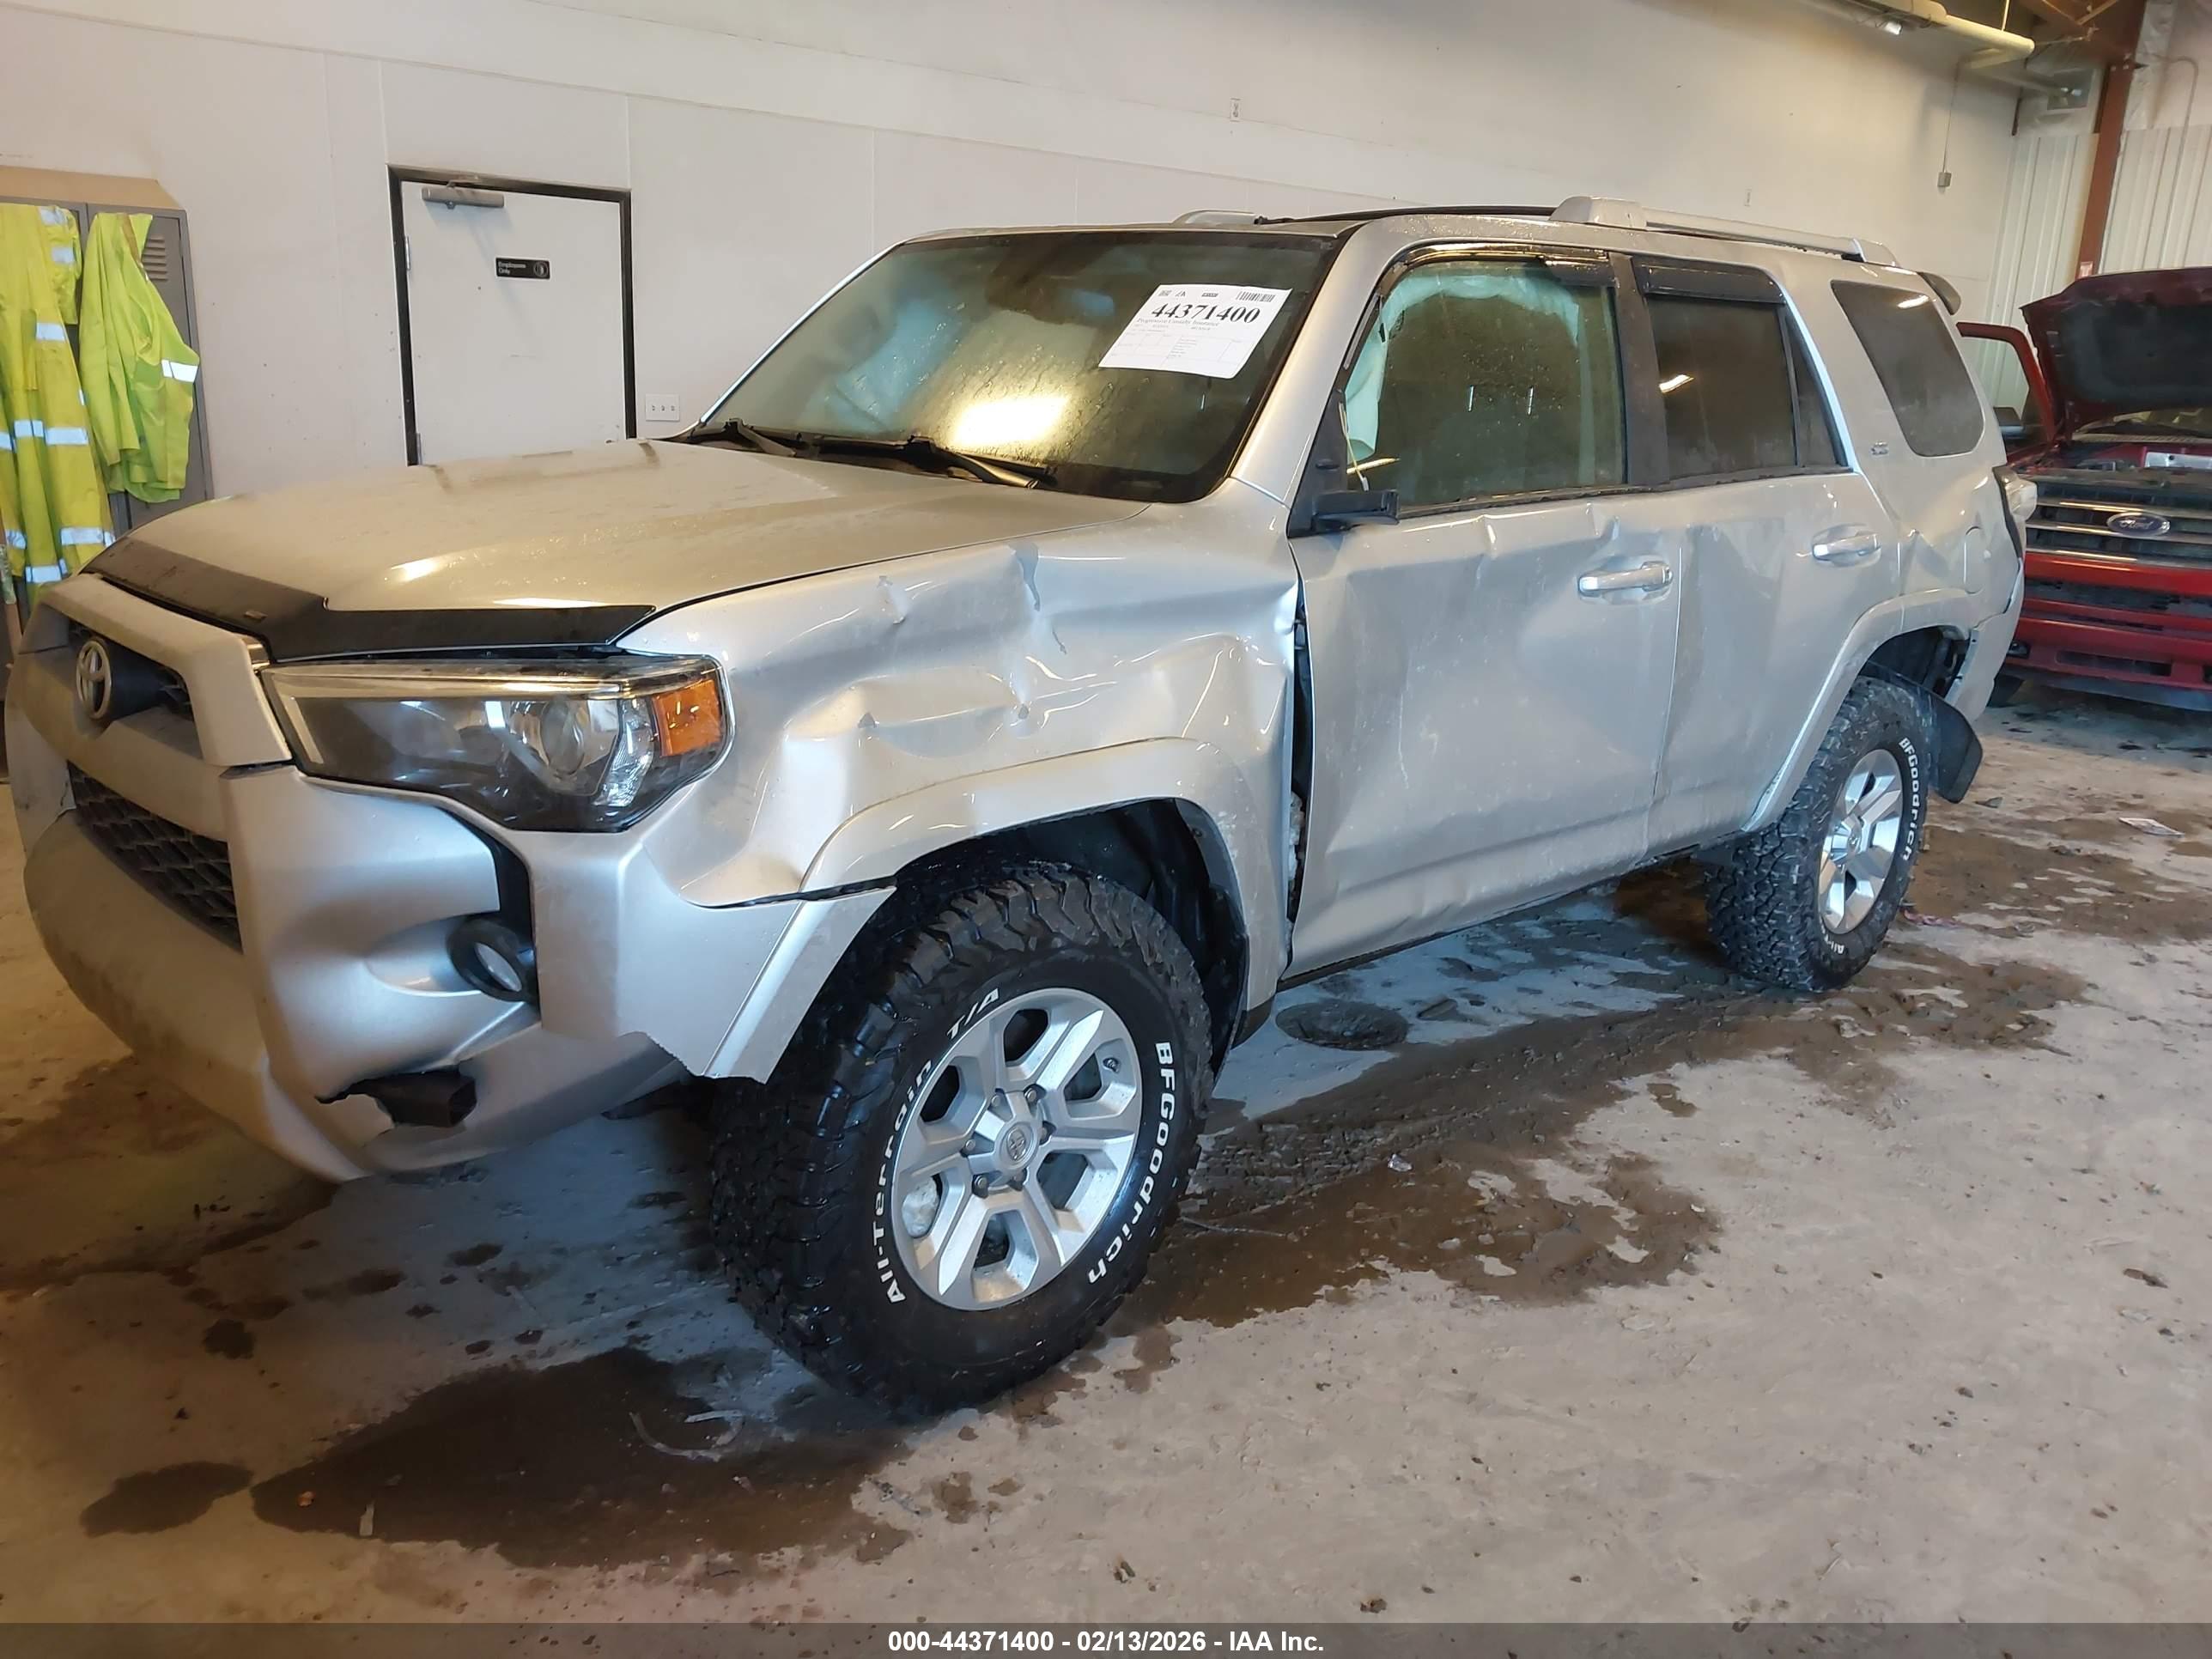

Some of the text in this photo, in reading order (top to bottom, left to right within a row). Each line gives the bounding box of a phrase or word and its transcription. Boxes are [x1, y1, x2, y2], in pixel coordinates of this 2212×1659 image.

[1152, 303, 1261, 324] 44371400
[1899, 737, 1921, 861] BFGoodrich
[946, 988, 1000, 1040] T/A
[1087, 1041, 1176, 1285] BFGoodrich
